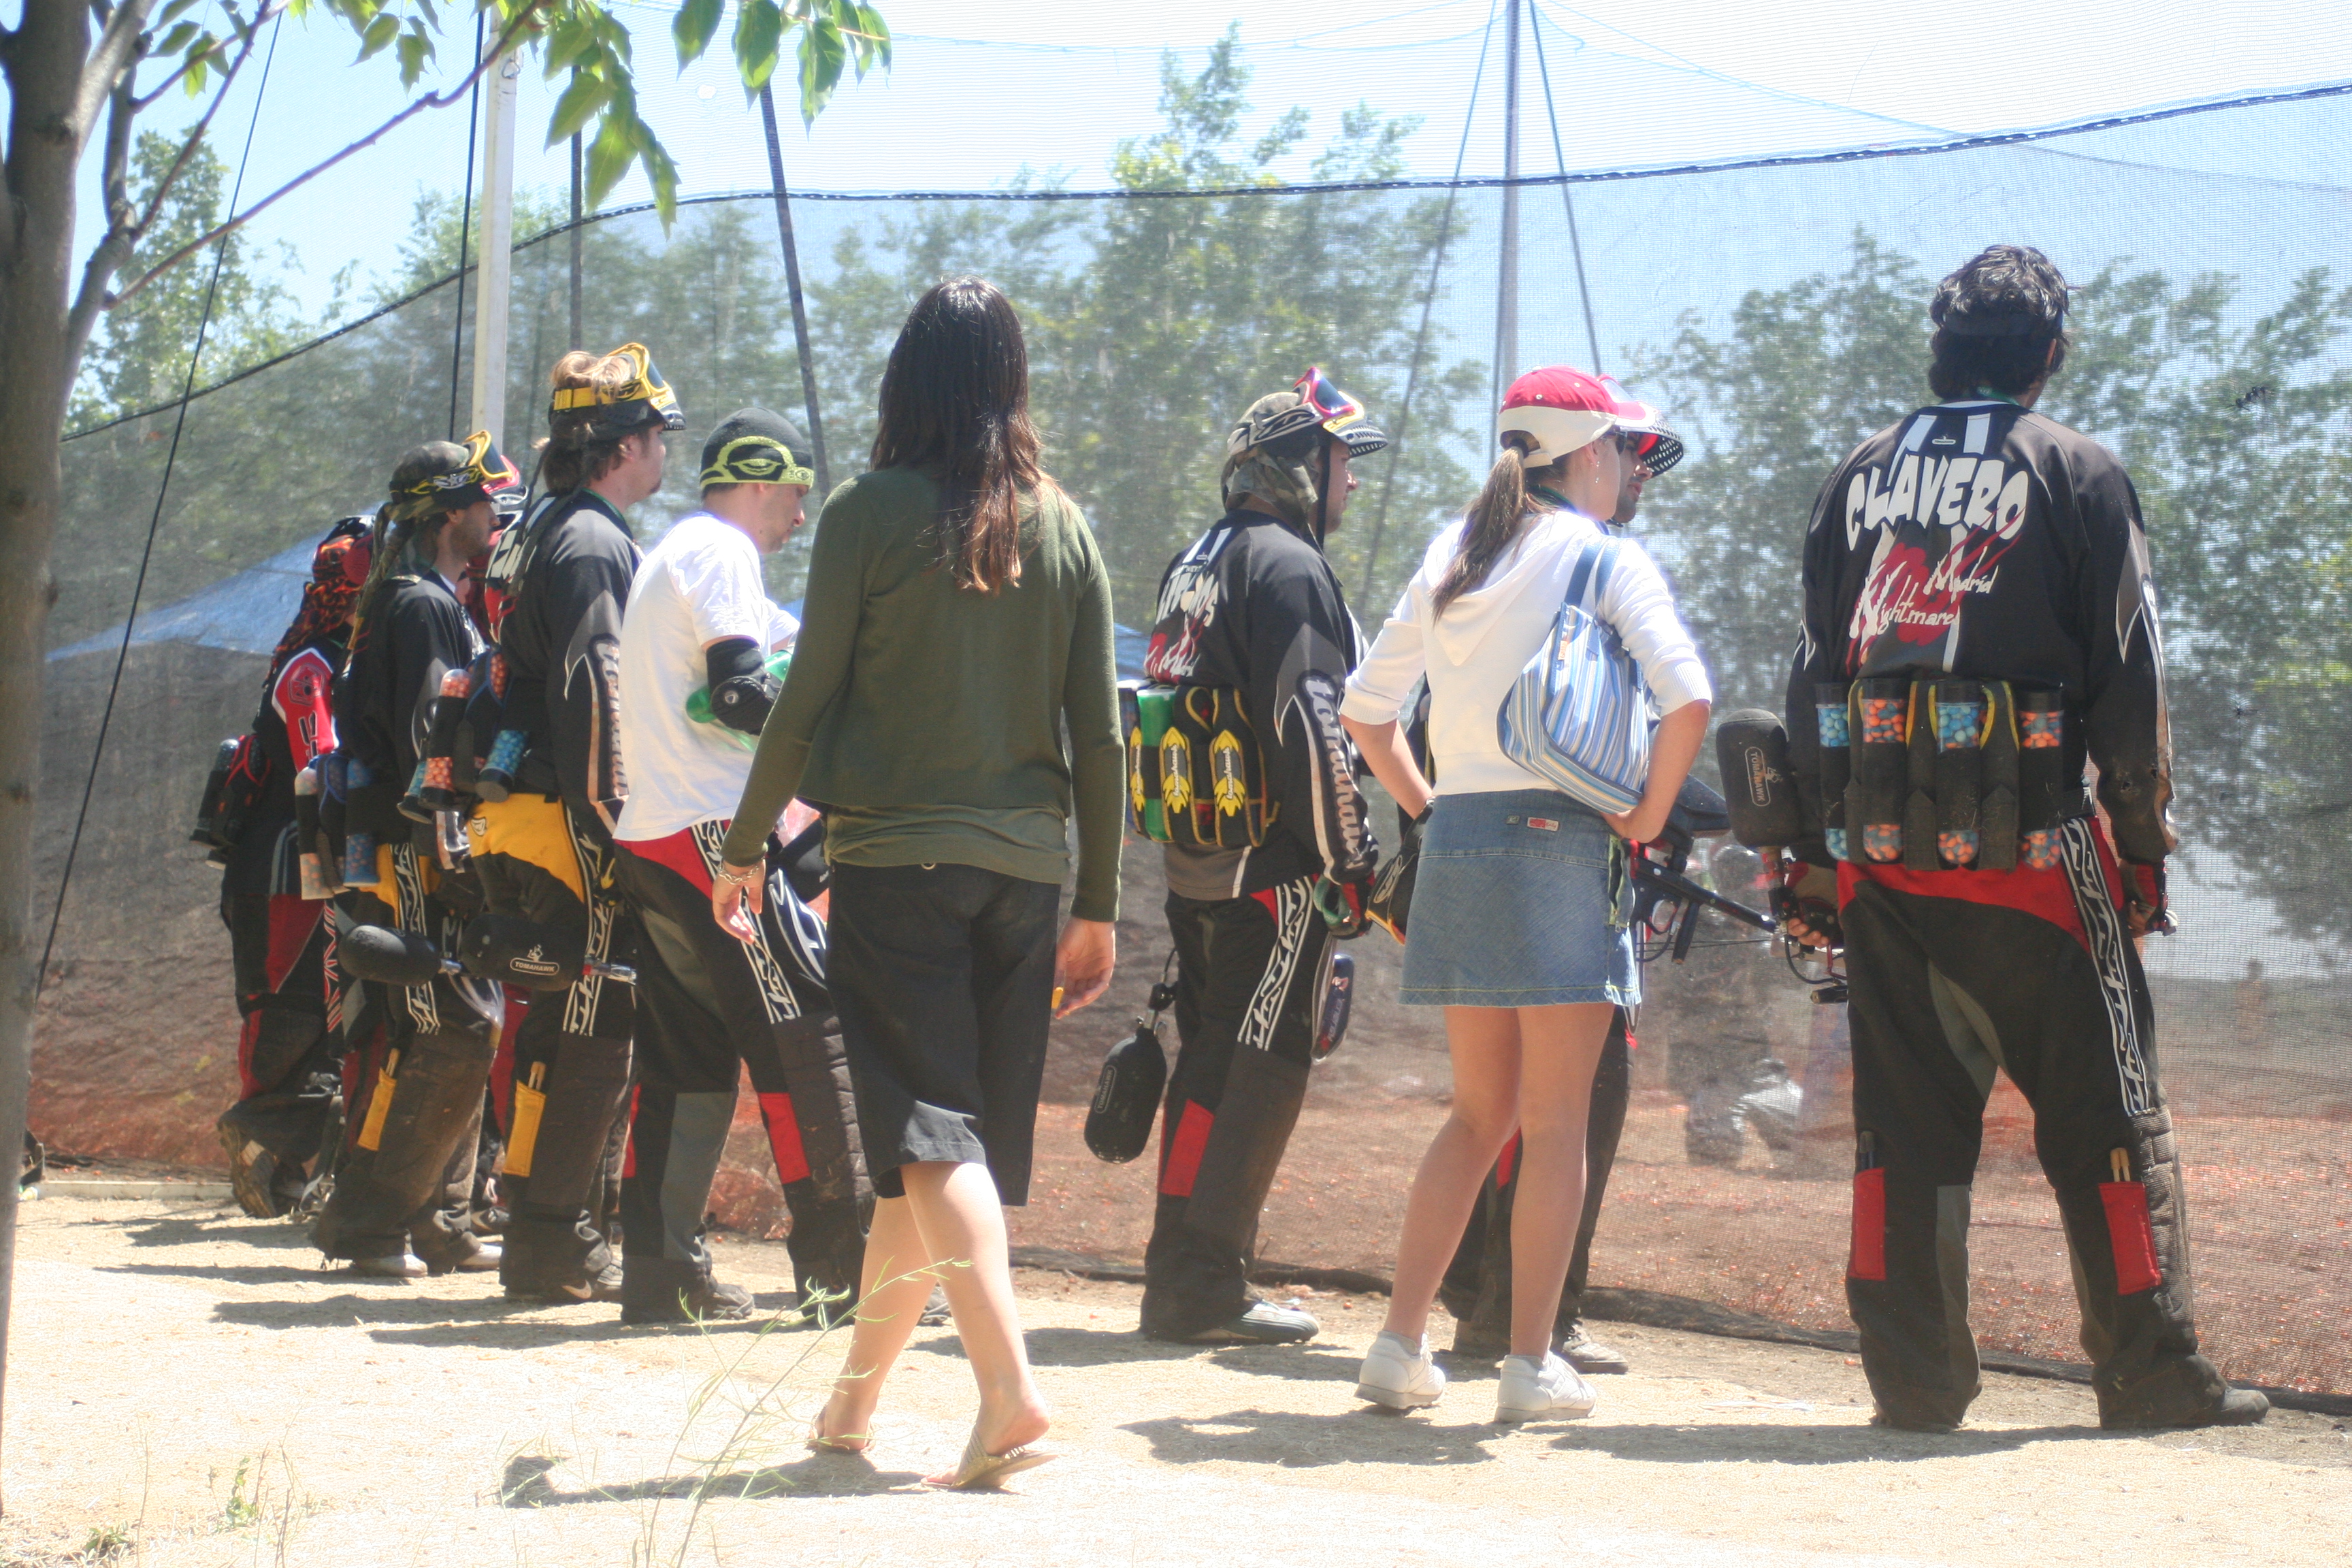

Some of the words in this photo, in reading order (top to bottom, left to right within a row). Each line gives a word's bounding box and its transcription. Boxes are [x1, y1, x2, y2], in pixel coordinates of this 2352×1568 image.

[1845, 453, 2029, 551] CLAVERO
[1923, 545, 1999, 596] Madrid
[1848, 560, 1956, 639] Nightmare
[1750, 751, 1766, 802] TOMAHAWK
[514, 961, 555, 973] TOMAHAWK
